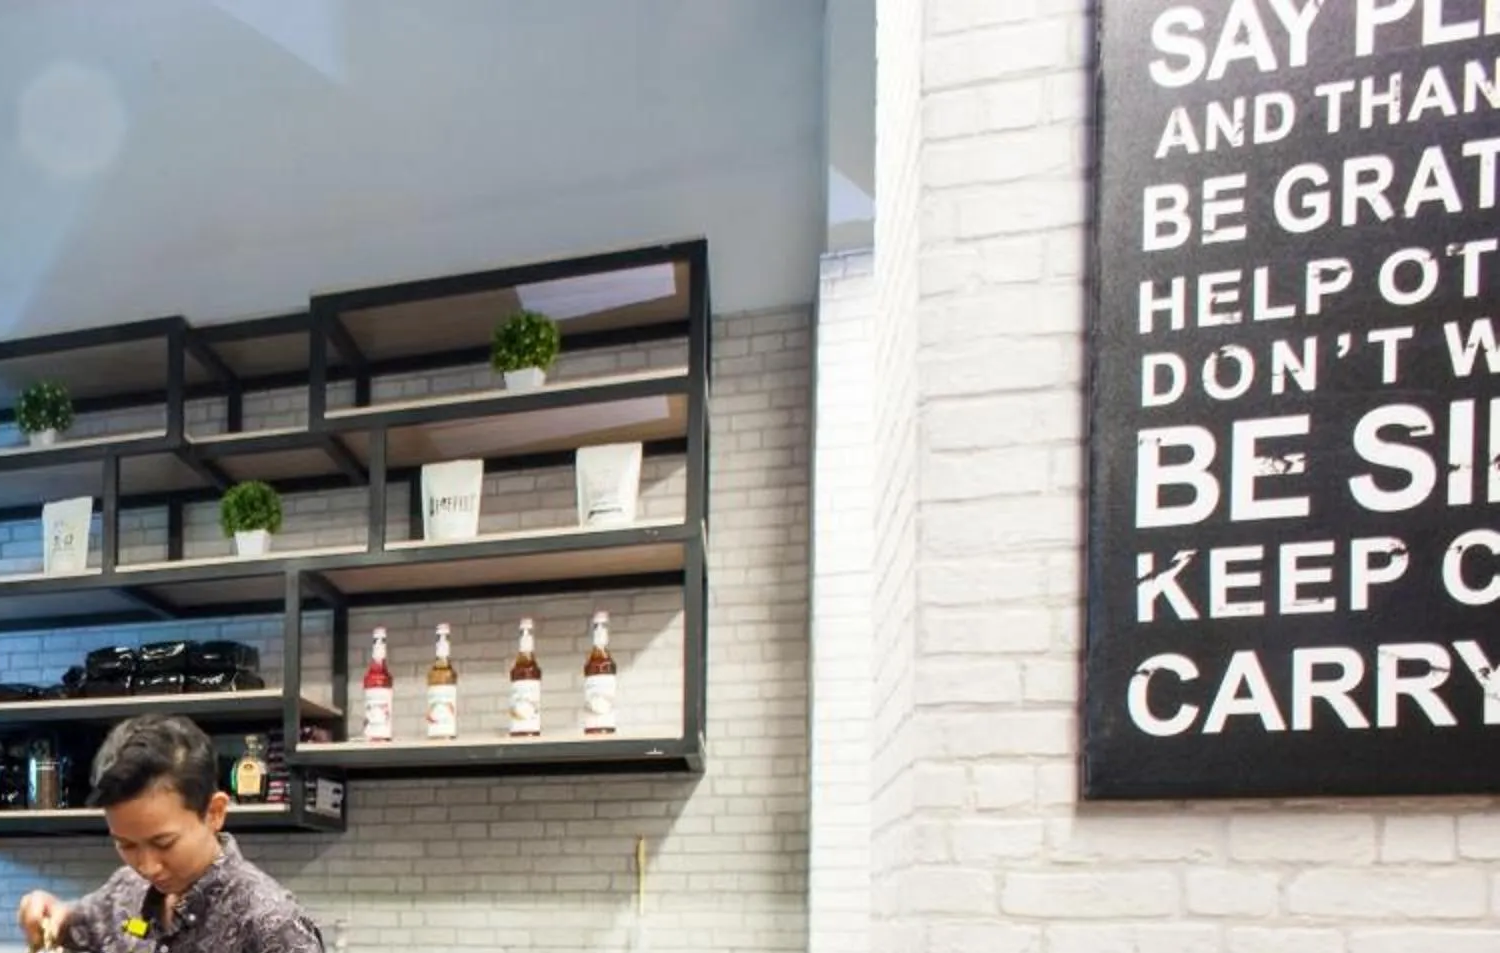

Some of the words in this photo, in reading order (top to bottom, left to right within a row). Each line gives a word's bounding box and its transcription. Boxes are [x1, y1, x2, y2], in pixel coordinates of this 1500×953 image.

[1148, 0, 1325, 88] SAY
[1355, 0, 1500, 57] PL
[1153, 91, 1297, 160] AND
[1314, 57, 1500, 134] THAN
[1141, 172, 1248, 252] BE
[1273, 137, 1500, 234] GRAT
[1138, 258, 1354, 334] HELP
[1378, 239, 1498, 305] OT
[1140, 327, 1414, 408] DON'T
[1135, 413, 1311, 529] BE
[1349, 397, 1500, 513] SI
[1136, 536, 1410, 623] KEEP
[1442, 529, 1500, 606] C
[1126, 640, 1500, 737] CARRY
